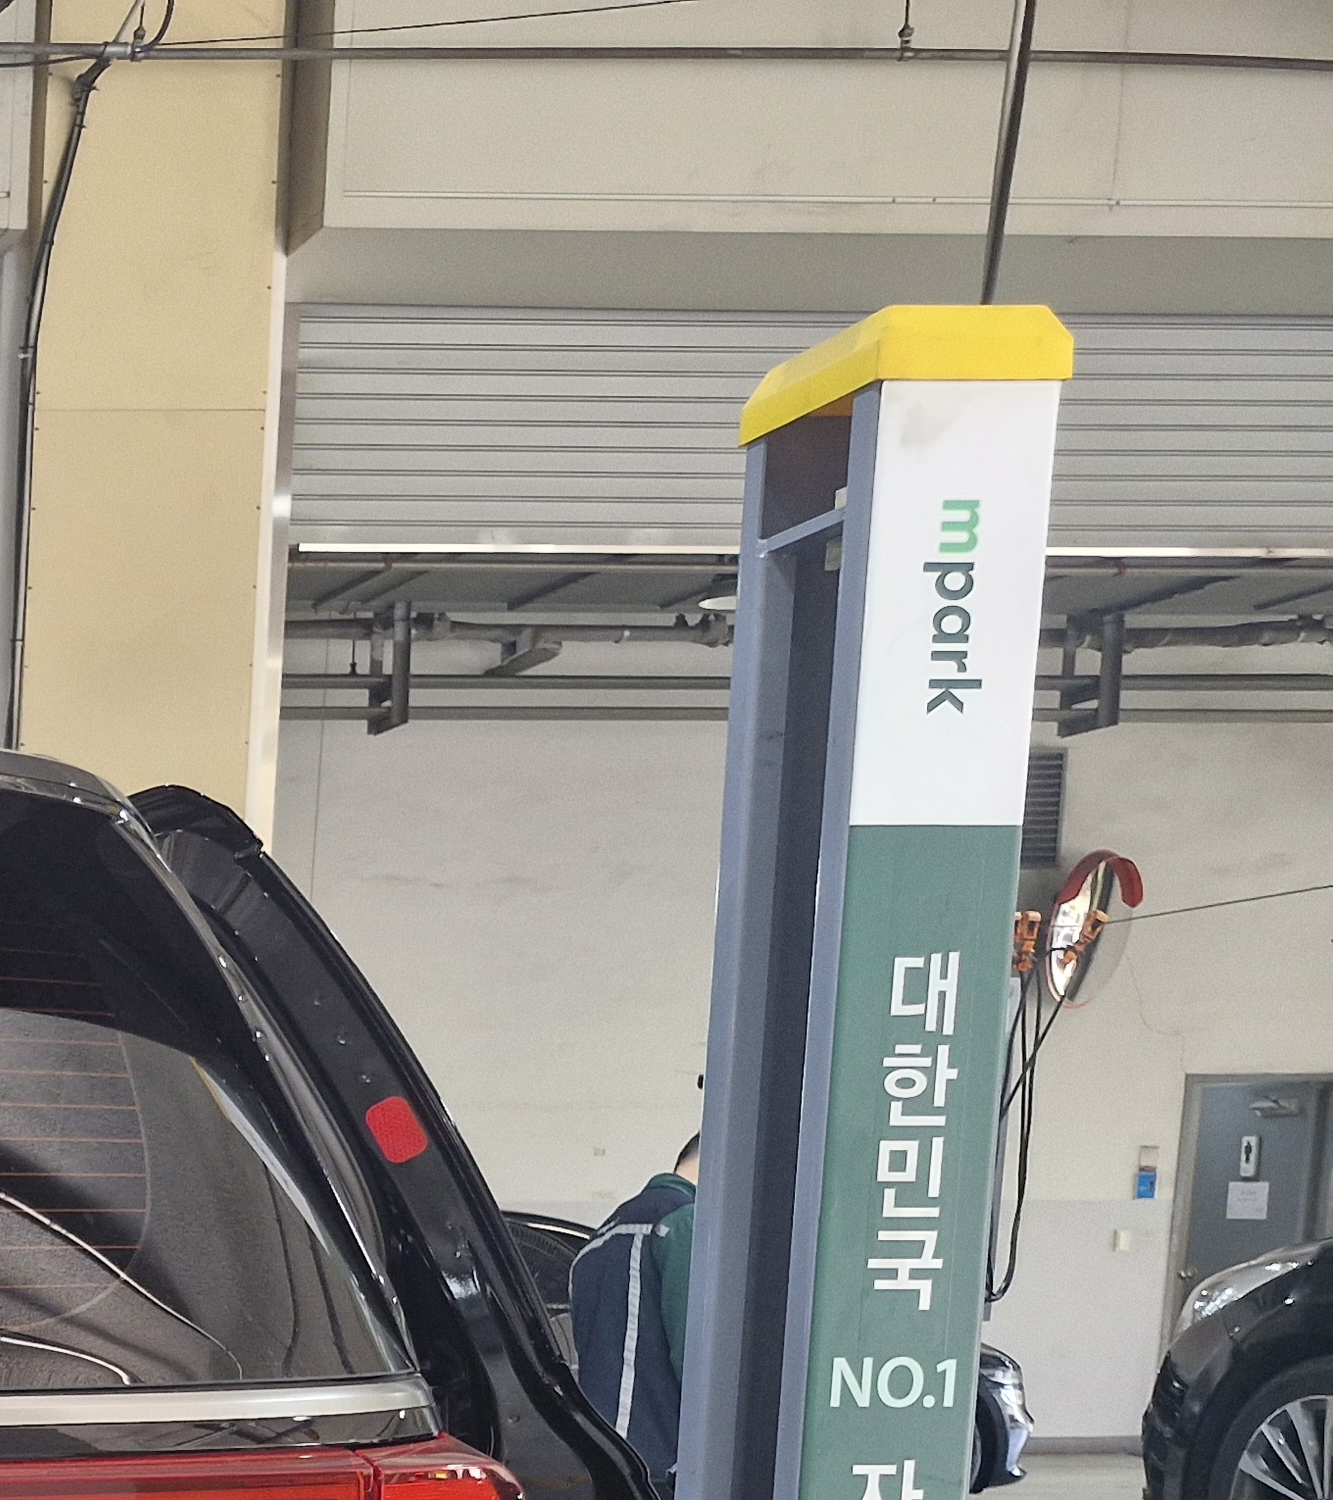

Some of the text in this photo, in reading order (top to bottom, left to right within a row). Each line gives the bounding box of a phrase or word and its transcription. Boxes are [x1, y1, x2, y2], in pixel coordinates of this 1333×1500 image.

[922, 499, 983, 715] mpark
[866, 950, 961, 1312] 대한민국
[828, 1355, 958, 1409] NO.1
